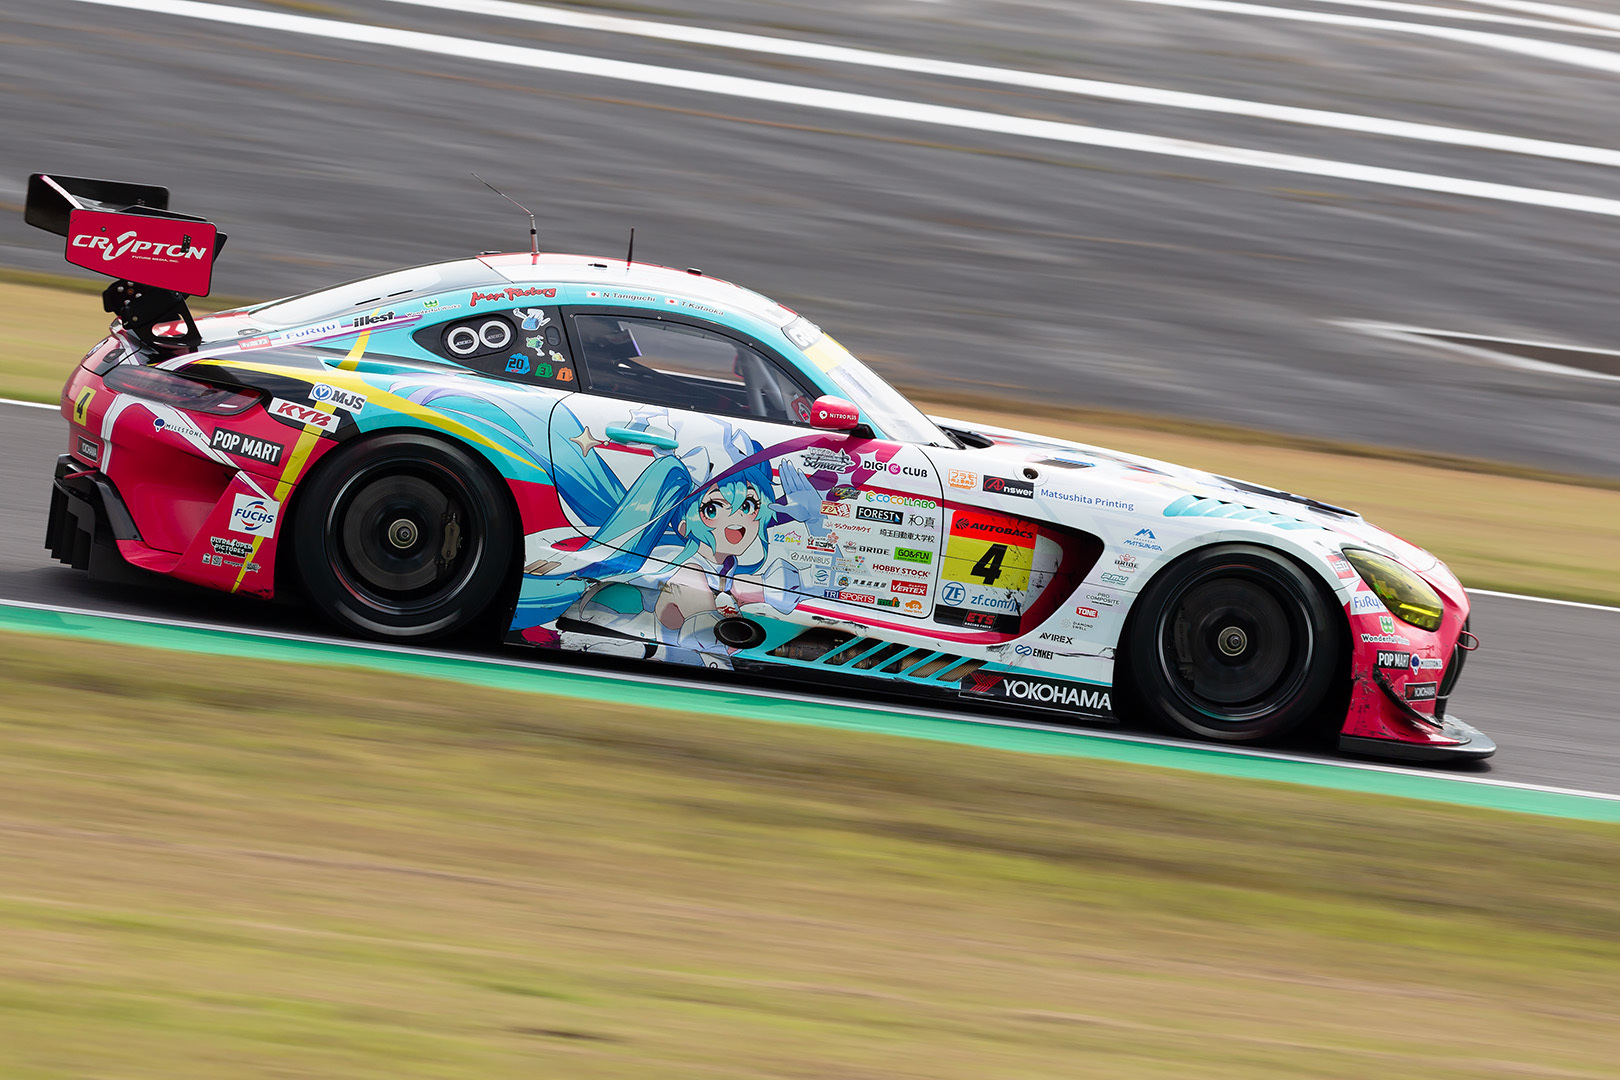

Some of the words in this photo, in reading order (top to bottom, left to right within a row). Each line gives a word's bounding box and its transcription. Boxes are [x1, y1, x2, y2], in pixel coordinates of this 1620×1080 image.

[72, 231, 207, 261] CRYPTON
[470, 291, 505, 306] Max
[503, 286, 556, 301] Factory
[353, 311, 394, 327] illest
[286, 324, 336, 340] FuRyu
[509, 357, 523, 369] 20
[77, 392, 91, 419] 4
[331, 390, 365, 410] MJS
[277, 401, 333, 427] KYB
[166, 423, 203, 438] MILESTONE
[212, 430, 240, 450] POP
[240, 438, 281, 462] MART
[864, 461, 887, 471] DIGI
[902, 467, 928, 477] CLUB
[984, 477, 1033, 496] Answer
[876, 494, 936, 509] COCOLLABO
[1041, 488, 1092, 504] Matsushita
[1095, 497, 1134, 511] Printing
[234, 508, 274, 523] FUCHS
[858, 508, 894, 520] FOREST
[880, 528, 935, 543] 埼玉自動車大学校
[970, 522, 1033, 539] AUTOBACS
[859, 545, 890, 555] BRIDE
[898, 549, 929, 560] GO&FUN
[801, 555, 830, 565] AMNIBUS
[970, 543, 1008, 585] 4
[872, 564, 900, 573] HOBBY
[902, 568, 928, 577] STOCK
[892, 583, 925, 594] VERTEX
[944, 585, 965, 602] ZF
[825, 590, 839, 599] TRI
[840, 592, 874, 603] SPORTS
[971, 594, 1021, 612] zf.com/jp
[1086, 595, 1120, 605] COMPOSITE
[966, 612, 995, 625] ETS
[1078, 607, 1096, 617] TONE
[1039, 632, 1073, 645] AVIREX
[1033, 648, 1054, 660] ENKEI
[1378, 652, 1393, 666] POP
[1394, 654, 1410, 666] MART
[1003, 679, 1112, 710] YOKOHAMA
